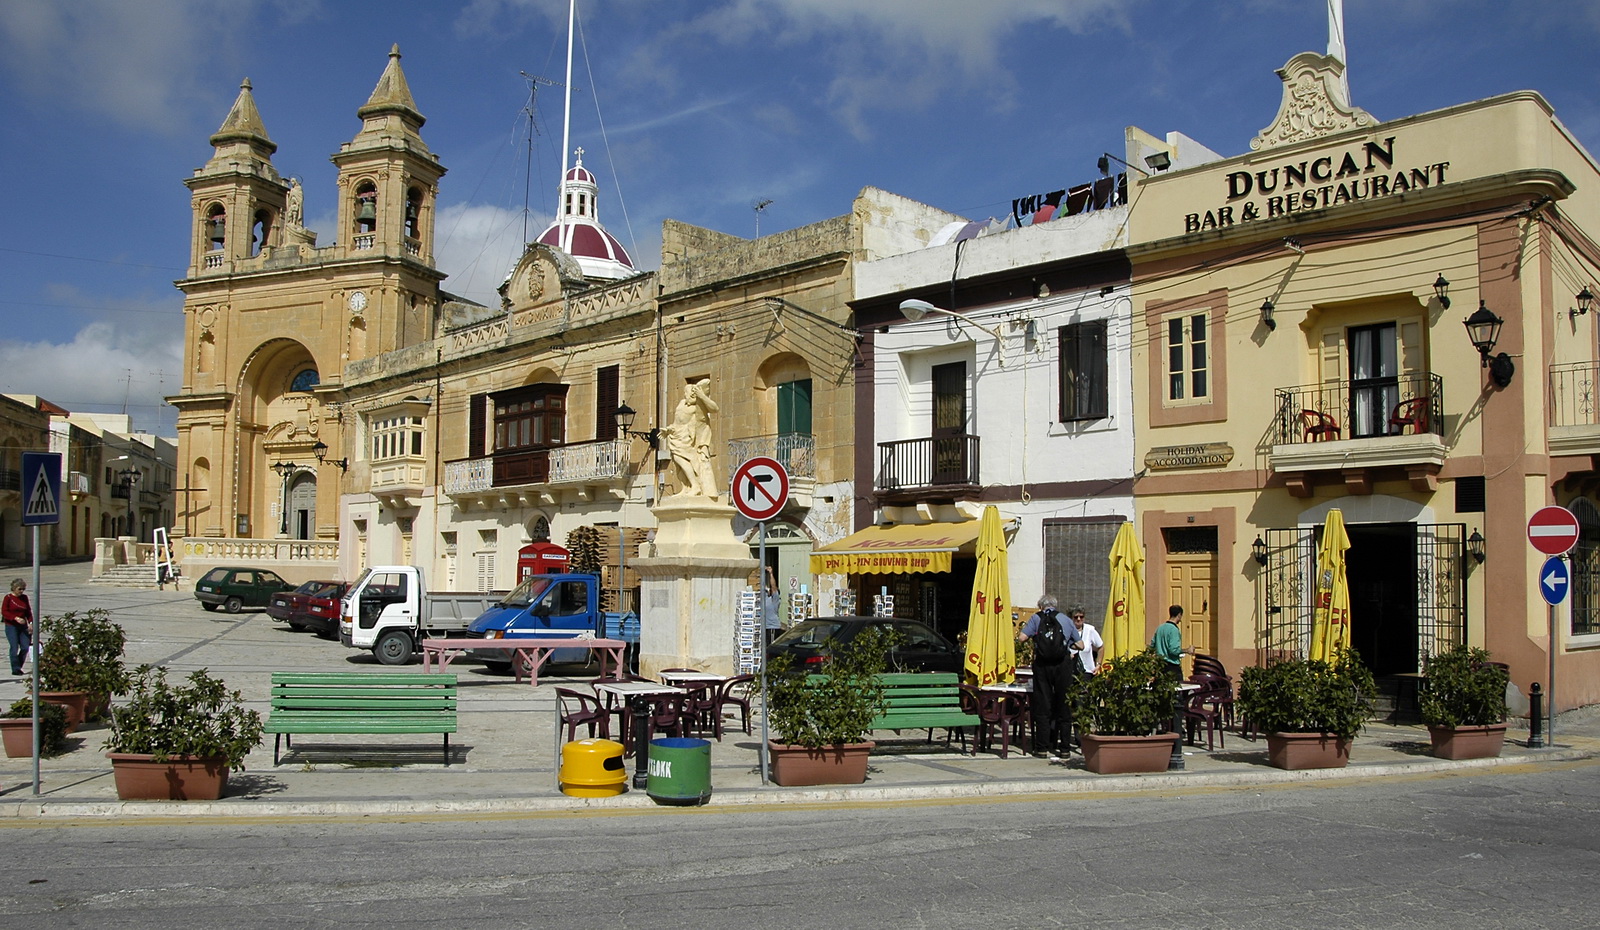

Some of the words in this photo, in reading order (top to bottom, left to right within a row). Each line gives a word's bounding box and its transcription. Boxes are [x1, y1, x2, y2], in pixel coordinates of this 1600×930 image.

[1226, 136, 1396, 199] DUNCAN
[1185, 204, 1234, 233] BAR
[1241, 201, 1261, 221] &
[1267, 162, 1450, 219] RESTAURANT
[1167, 446, 1206, 456] HOLIDAY
[1154, 455, 1225, 467] ACCOMODATION
[849, 537, 954, 548] Kodak
[873, 557, 908, 567] SOUVENIR
[910, 558, 930, 568] SHOP
